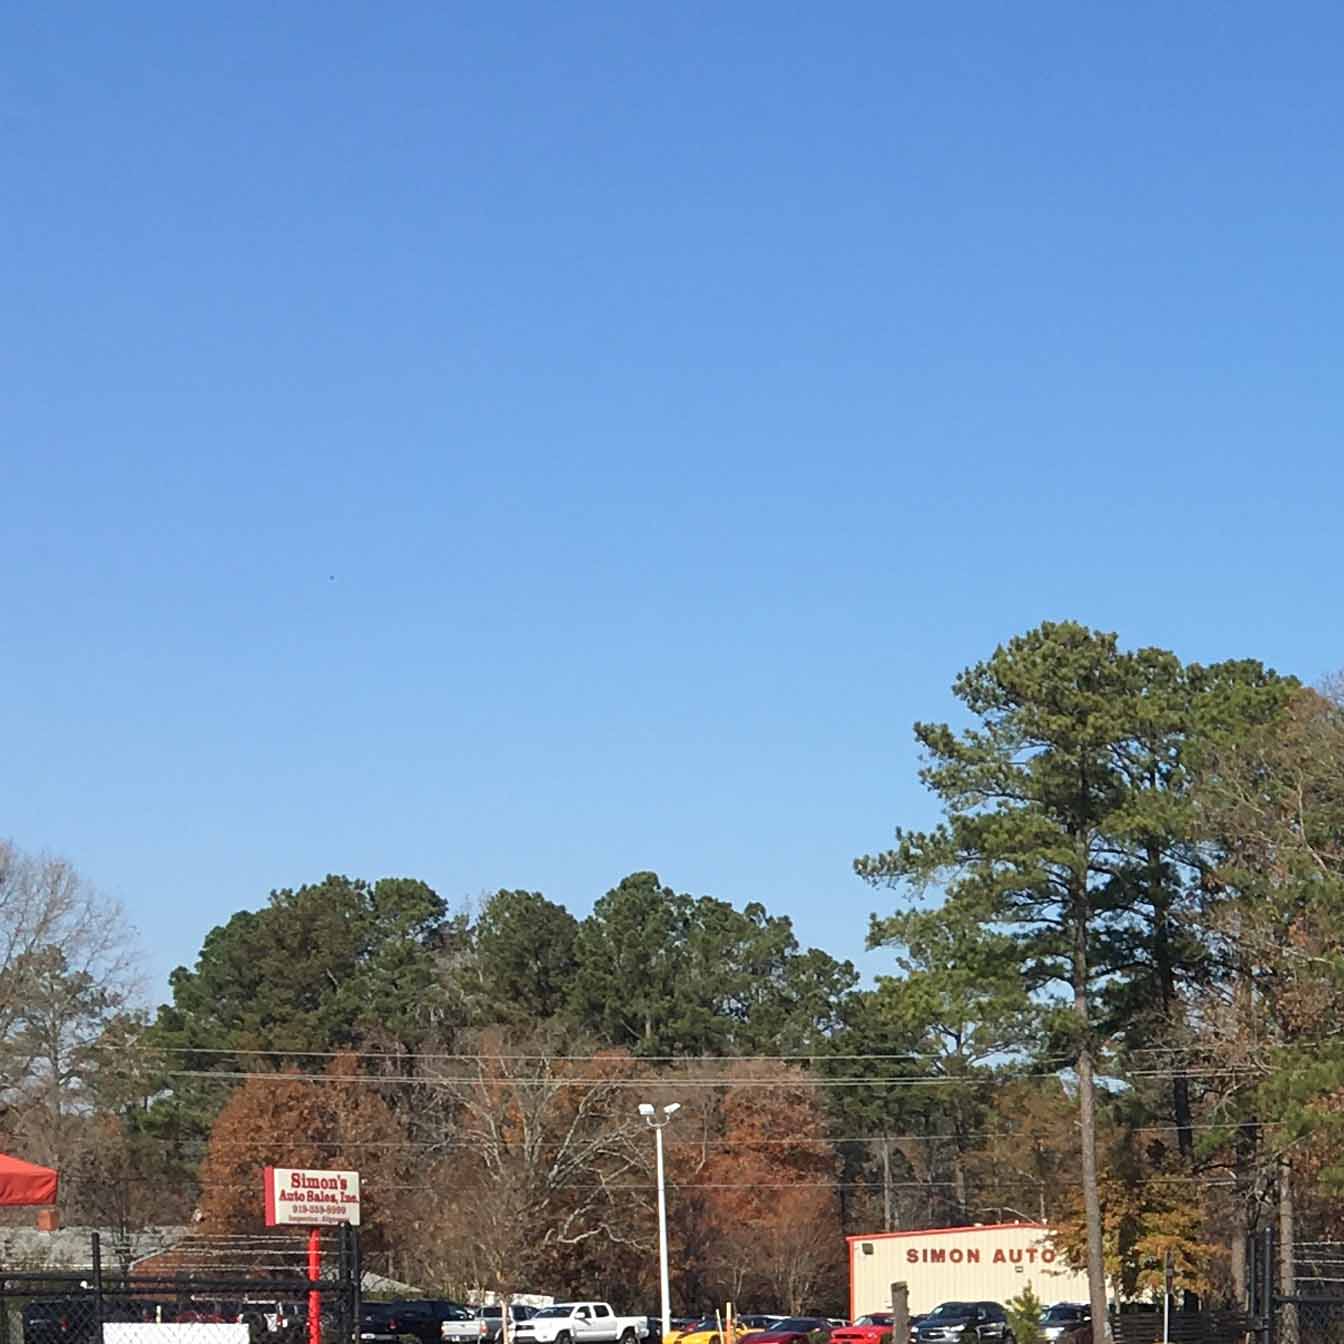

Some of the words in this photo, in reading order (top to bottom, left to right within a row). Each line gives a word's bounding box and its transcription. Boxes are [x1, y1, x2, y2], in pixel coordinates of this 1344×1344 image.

[291, 1173, 348, 1190] Simon's
[279, 1190, 306, 1202] Auto
[306, 1191, 338, 1204] Sales,
[906, 1248, 980, 1263] SIMON
[992, 1248, 1056, 1263] AUTO
